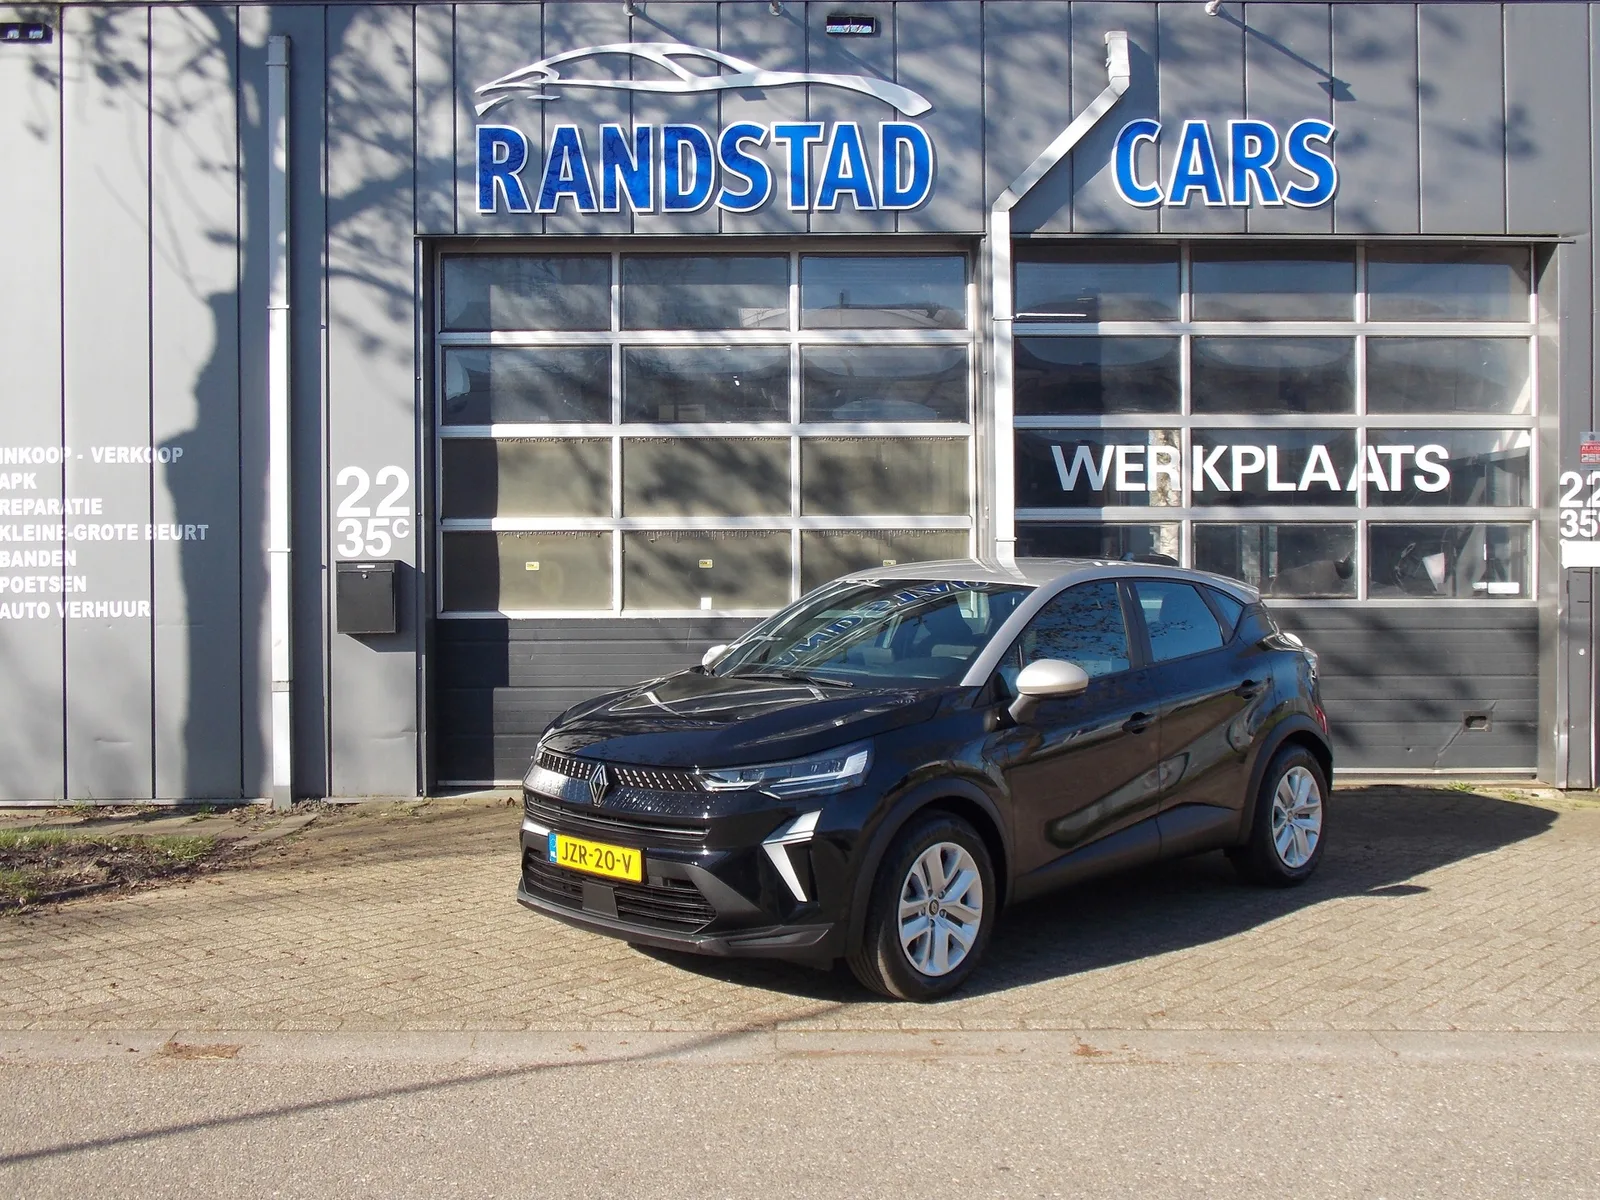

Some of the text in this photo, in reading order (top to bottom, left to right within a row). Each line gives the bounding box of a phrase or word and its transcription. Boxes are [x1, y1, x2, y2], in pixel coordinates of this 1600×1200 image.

[475, 118, 1338, 214] RANDSTAD CARS
[0, 446, 72, 464] INKOOP
[91, 446, 183, 463] VERKOOP
[1051, 445, 1450, 492] WERKPLAATS
[0, 472, 37, 490] APK
[336, 465, 410, 517] 22
[0, 498, 102, 516] REPARATIE
[0, 523, 209, 541] KLEINE-GROTE BEURT
[1560, 509, 1600, 538] 35
[0, 550, 76, 567] BANDEN
[0, 576, 87, 594] POETSEN
[0, 601, 150, 619] AUTO VERHUUR
[562, 841, 631, 874] JZR-20-V
